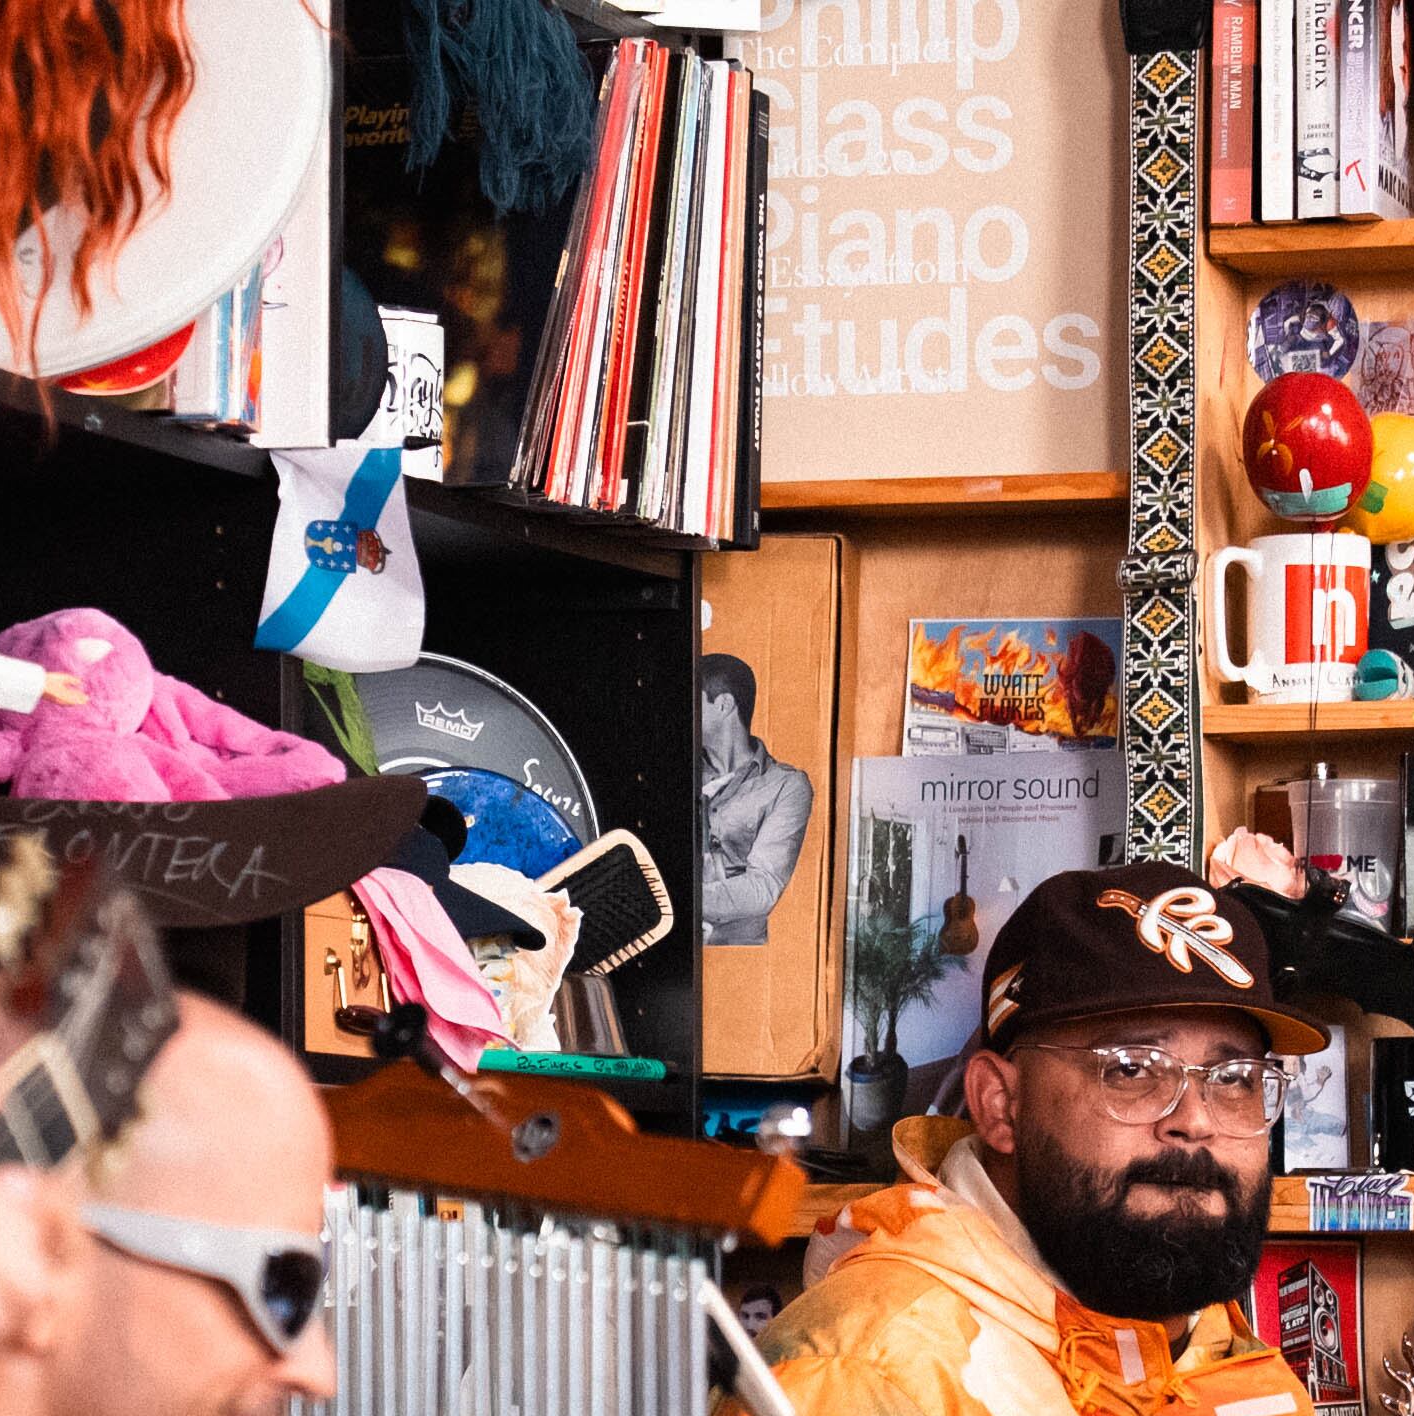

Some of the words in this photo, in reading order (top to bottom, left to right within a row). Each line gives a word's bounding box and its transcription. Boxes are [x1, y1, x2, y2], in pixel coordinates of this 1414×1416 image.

[1230, 16, 1244, 78] RAMBLIN'
[1229, 80, 1242, 110] MAN
[757, 193, 765, 226] THE
[768, 184, 1031, 288] Piano
[756, 230, 765, 292] WORLD
[756, 294, 763, 319] OF
[754, 386, 762, 452] STUART
[982, 674, 1044, 696] WYATT
[1271, 671, 1317, 689] ANNIE
[422, 712, 475, 738] REMO
[977, 697, 1046, 724] FLORES
[921, 772, 1007, 802] mirror
[1012, 769, 1100, 801] sound
[1346, 856, 1376, 873] ME
